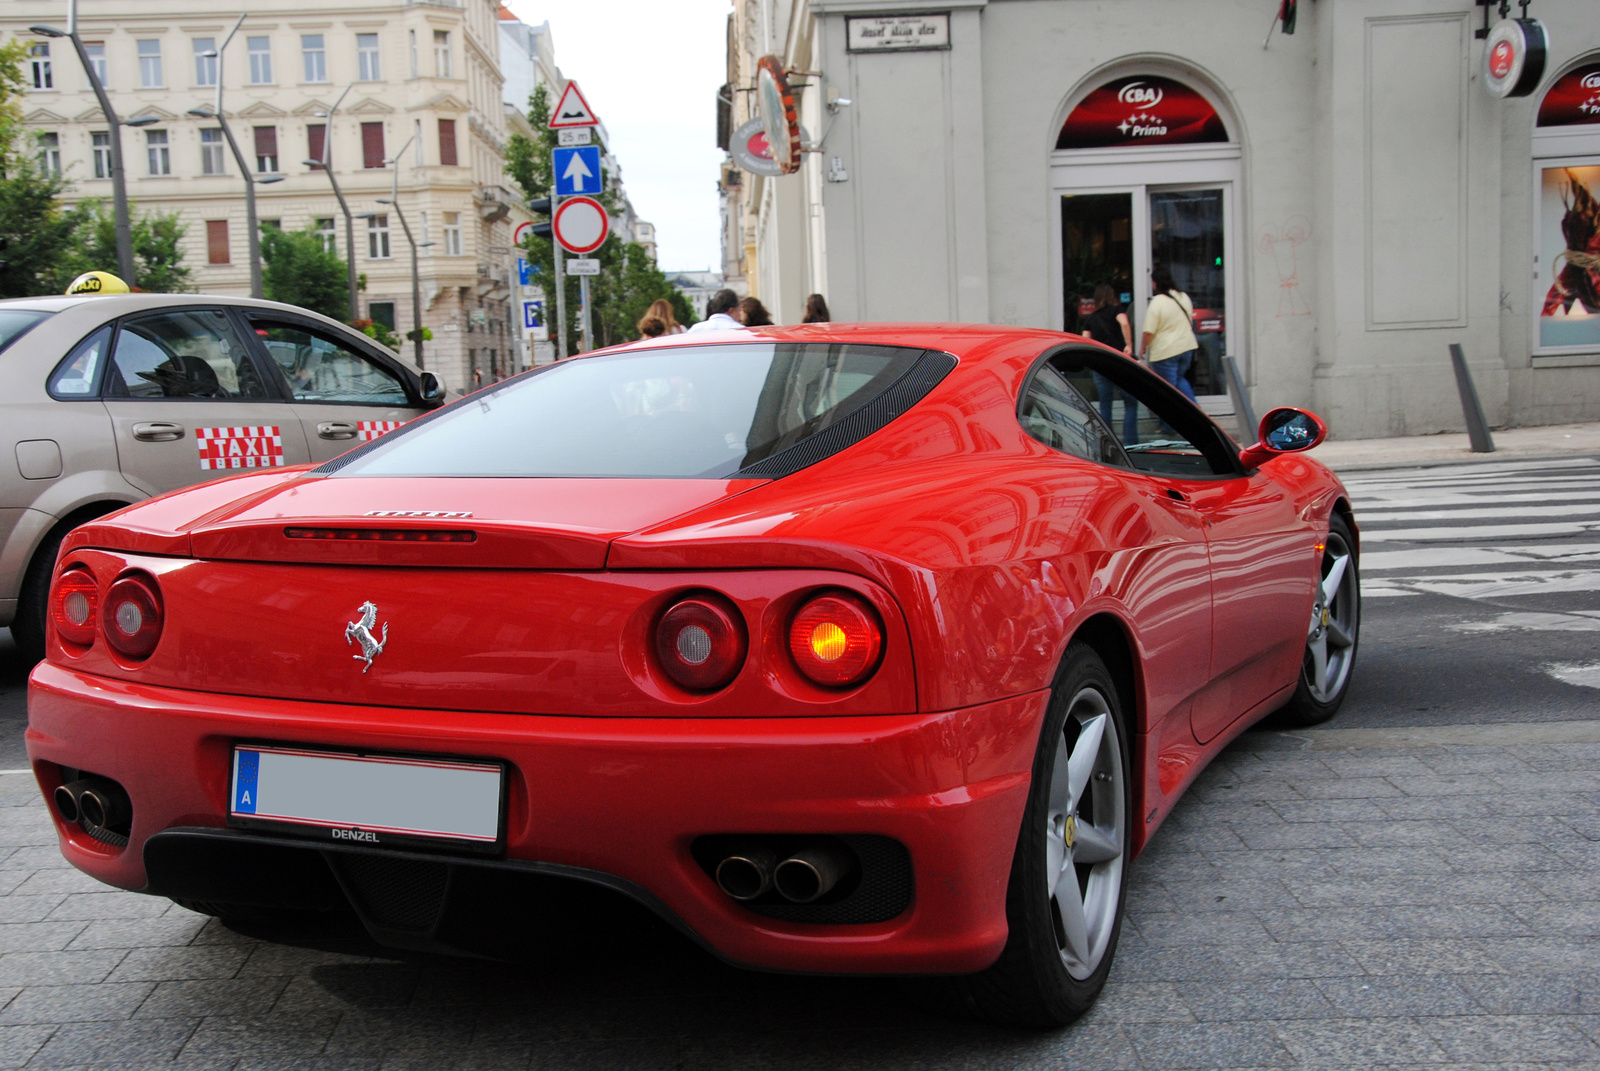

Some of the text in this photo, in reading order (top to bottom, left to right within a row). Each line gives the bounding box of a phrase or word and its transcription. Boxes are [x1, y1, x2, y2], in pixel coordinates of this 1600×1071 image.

[1125, 88, 1156, 103] CBA
[562, 132, 588, 142] 25 m
[213, 438, 269, 457] TAXI
[241, 790, 251, 804] A
[331, 828, 380, 843] DENZEL
